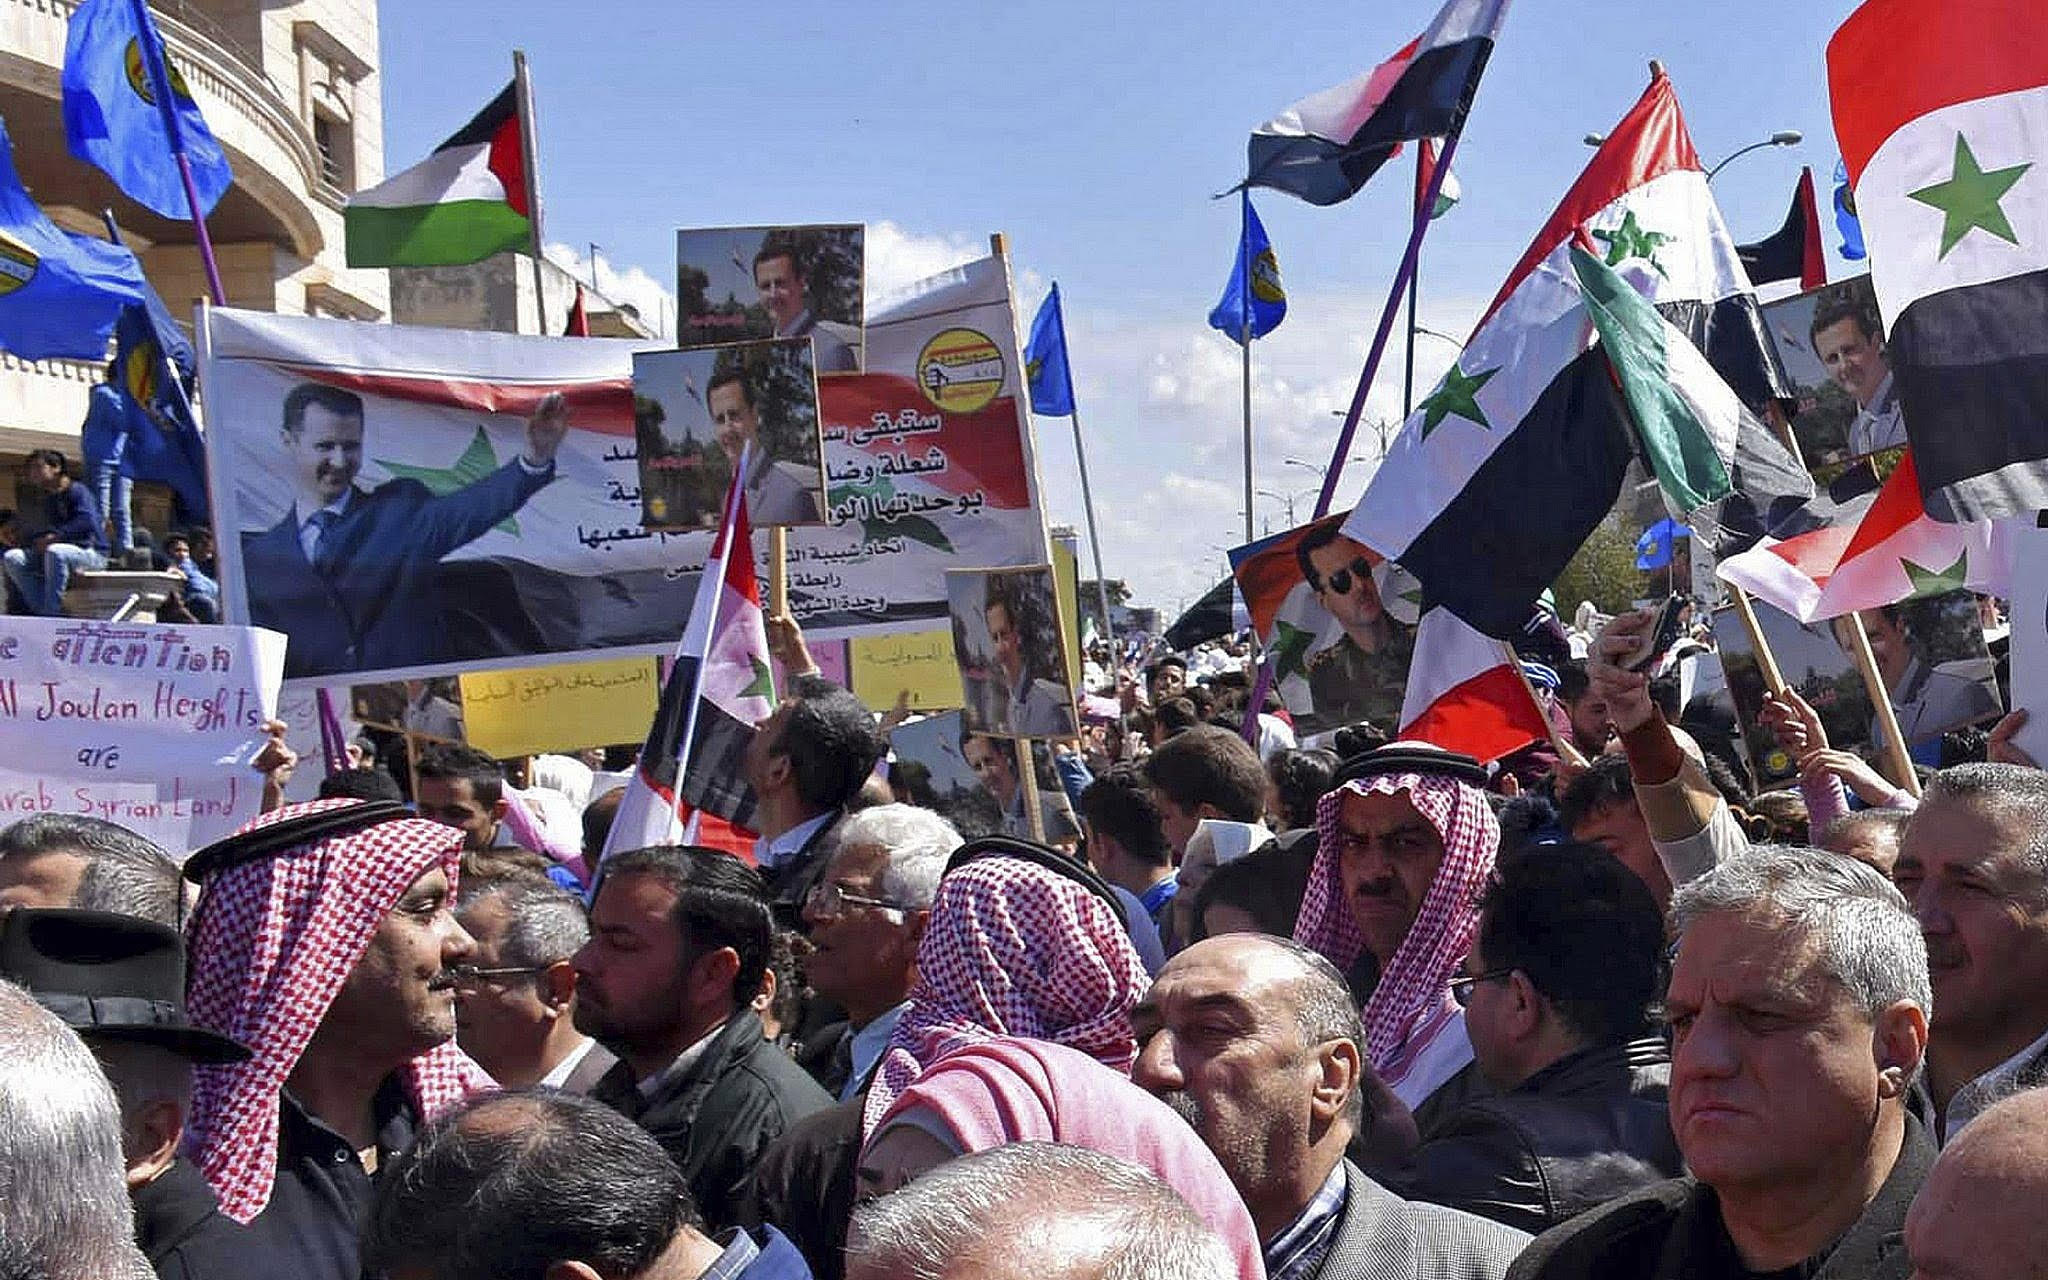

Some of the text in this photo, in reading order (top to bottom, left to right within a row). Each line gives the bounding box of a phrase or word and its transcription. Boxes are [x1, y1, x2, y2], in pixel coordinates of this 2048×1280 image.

[852, 410, 941, 445] ستبقى
[878, 447, 946, 475] شعلة
[873, 490, 983, 522] بوحدتها
[36, 681, 137, 722] Joulan
[154, 680, 259, 731] Heights
[77, 745, 121, 769] are
[0, 776, 239, 820] rab Syrian Land
